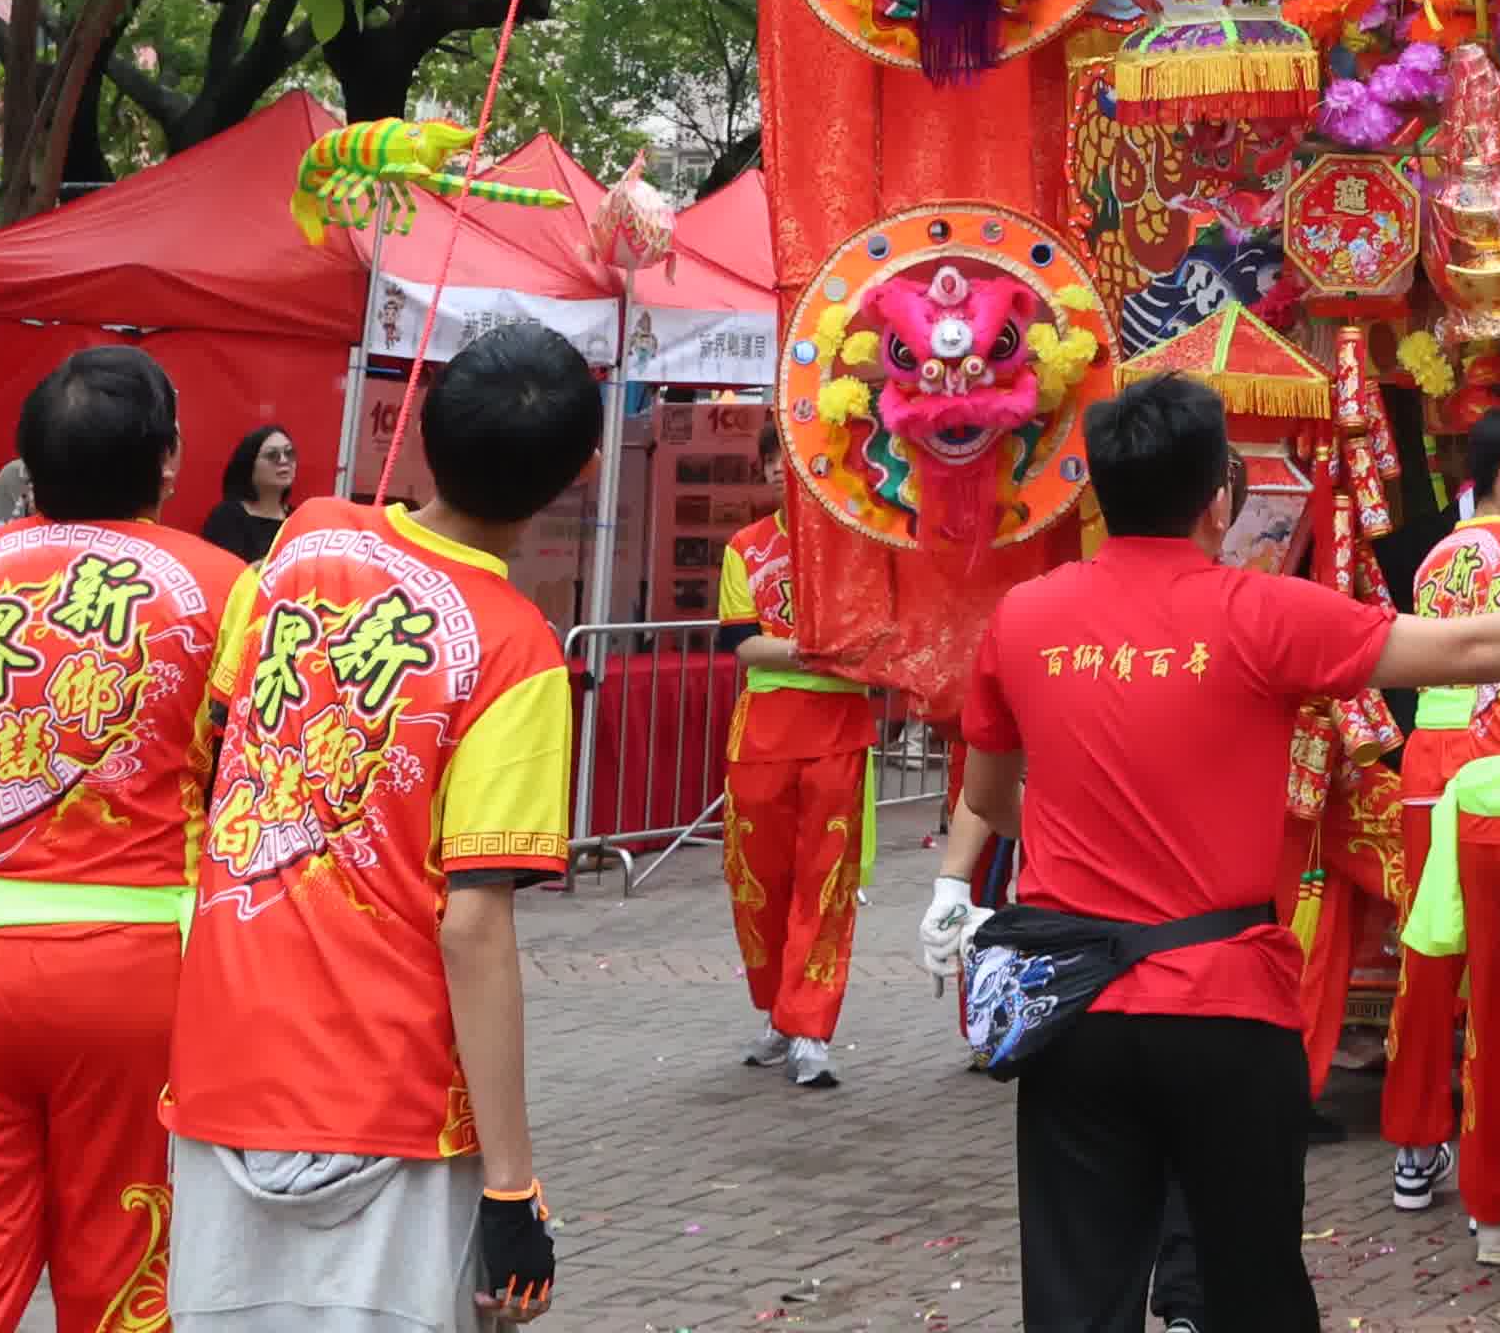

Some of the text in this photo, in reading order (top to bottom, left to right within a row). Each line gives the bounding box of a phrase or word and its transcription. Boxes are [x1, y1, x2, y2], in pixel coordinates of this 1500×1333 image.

[250, 587, 439, 731] 新界
[1039, 640, 1212, 685] 百獅賀百年
[207, 705, 366, 876] 鄉議局
